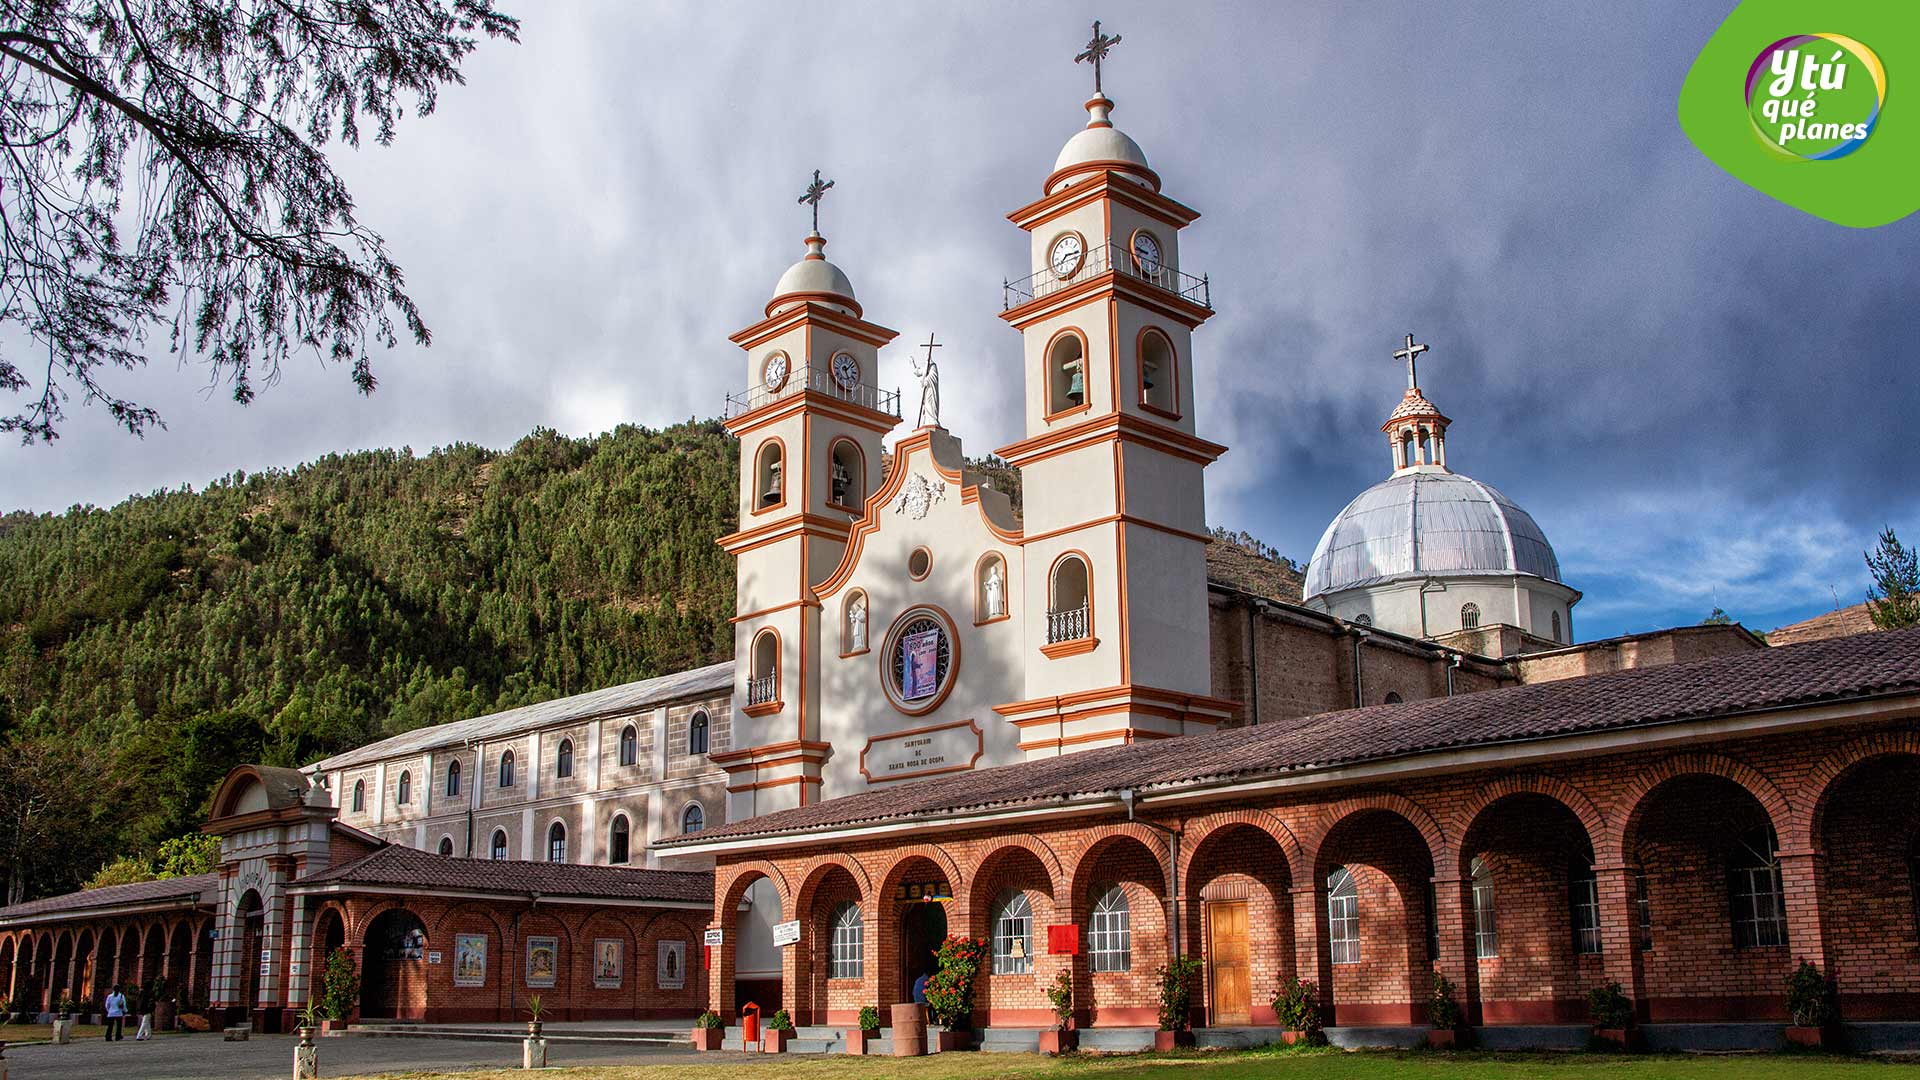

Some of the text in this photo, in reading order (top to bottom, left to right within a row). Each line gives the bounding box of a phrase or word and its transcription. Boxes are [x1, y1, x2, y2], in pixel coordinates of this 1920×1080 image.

[915, 749, 922, 757] DE
[888, 755, 945, 771] SANTA ROSA DE OCOPA
